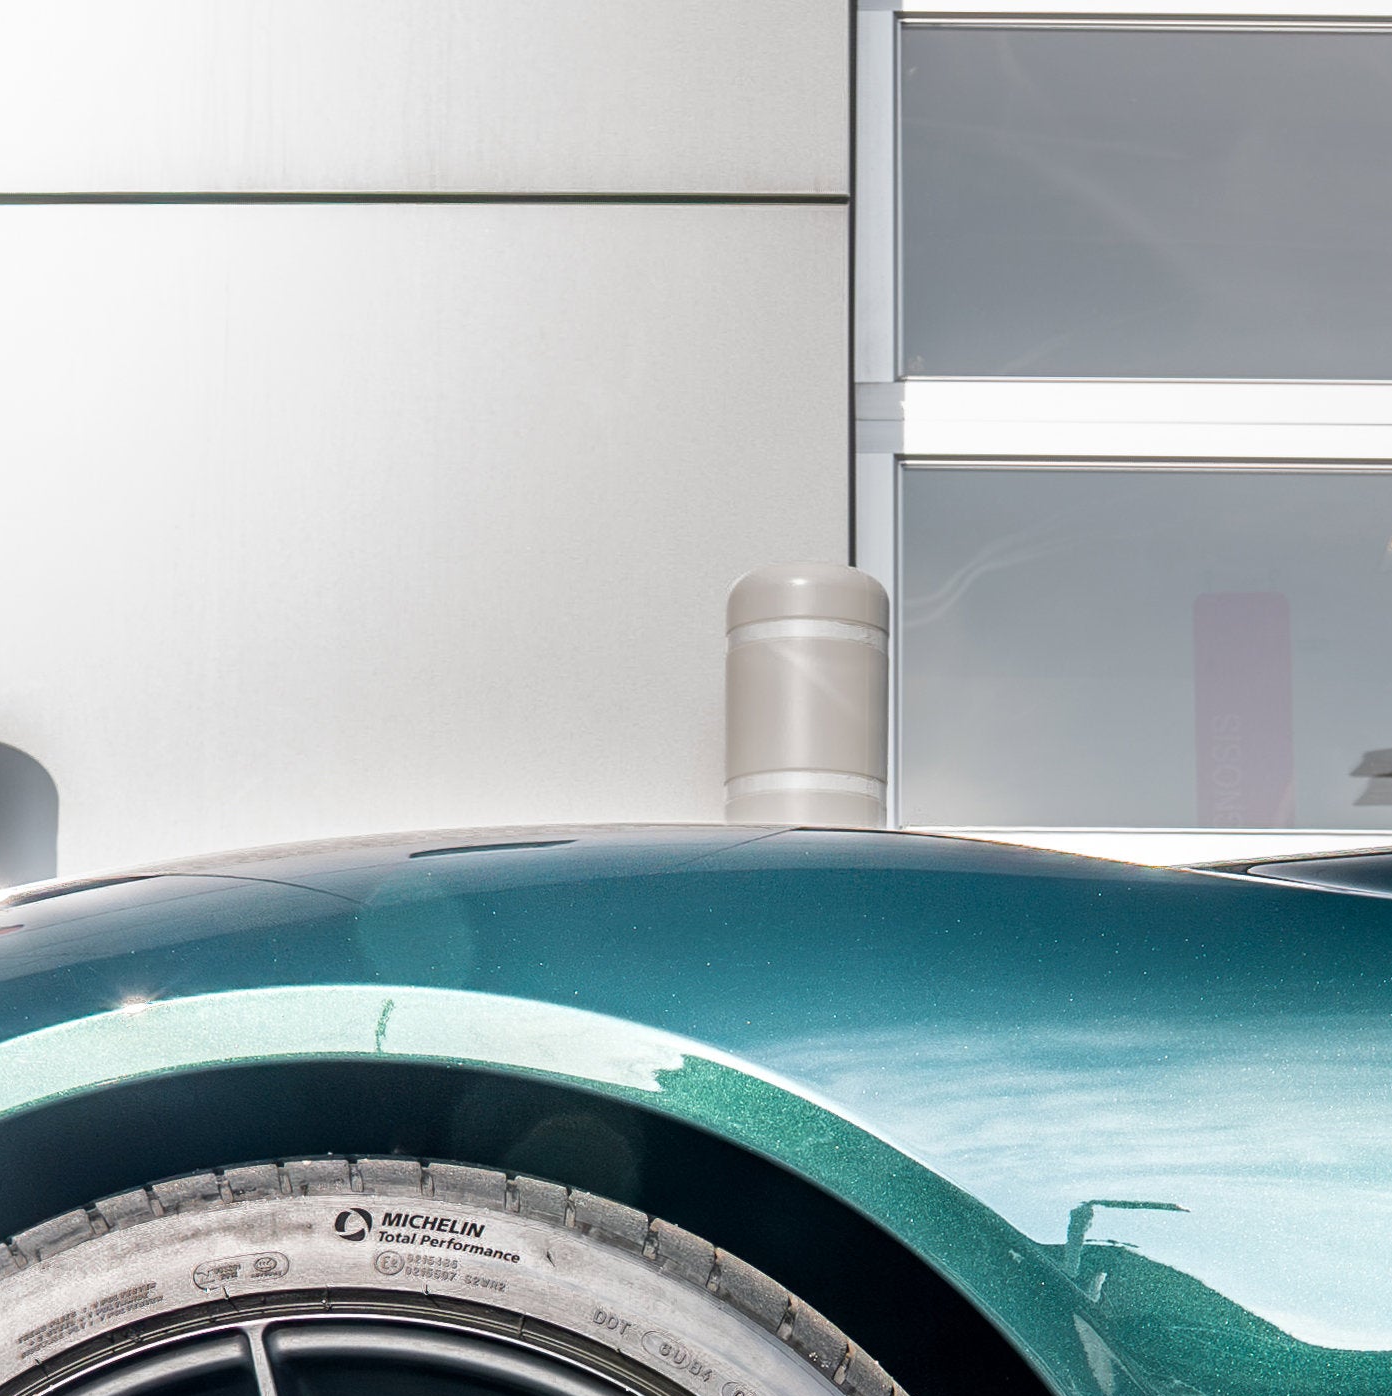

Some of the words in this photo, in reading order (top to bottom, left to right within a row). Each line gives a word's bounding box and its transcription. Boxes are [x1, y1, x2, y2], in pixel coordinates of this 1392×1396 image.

[382, 1212, 486, 1238] MICHELIN
[378, 1231, 417, 1245] Total
[419, 1235, 521, 1264] Performance
[593, 1308, 631, 1336] DOT
